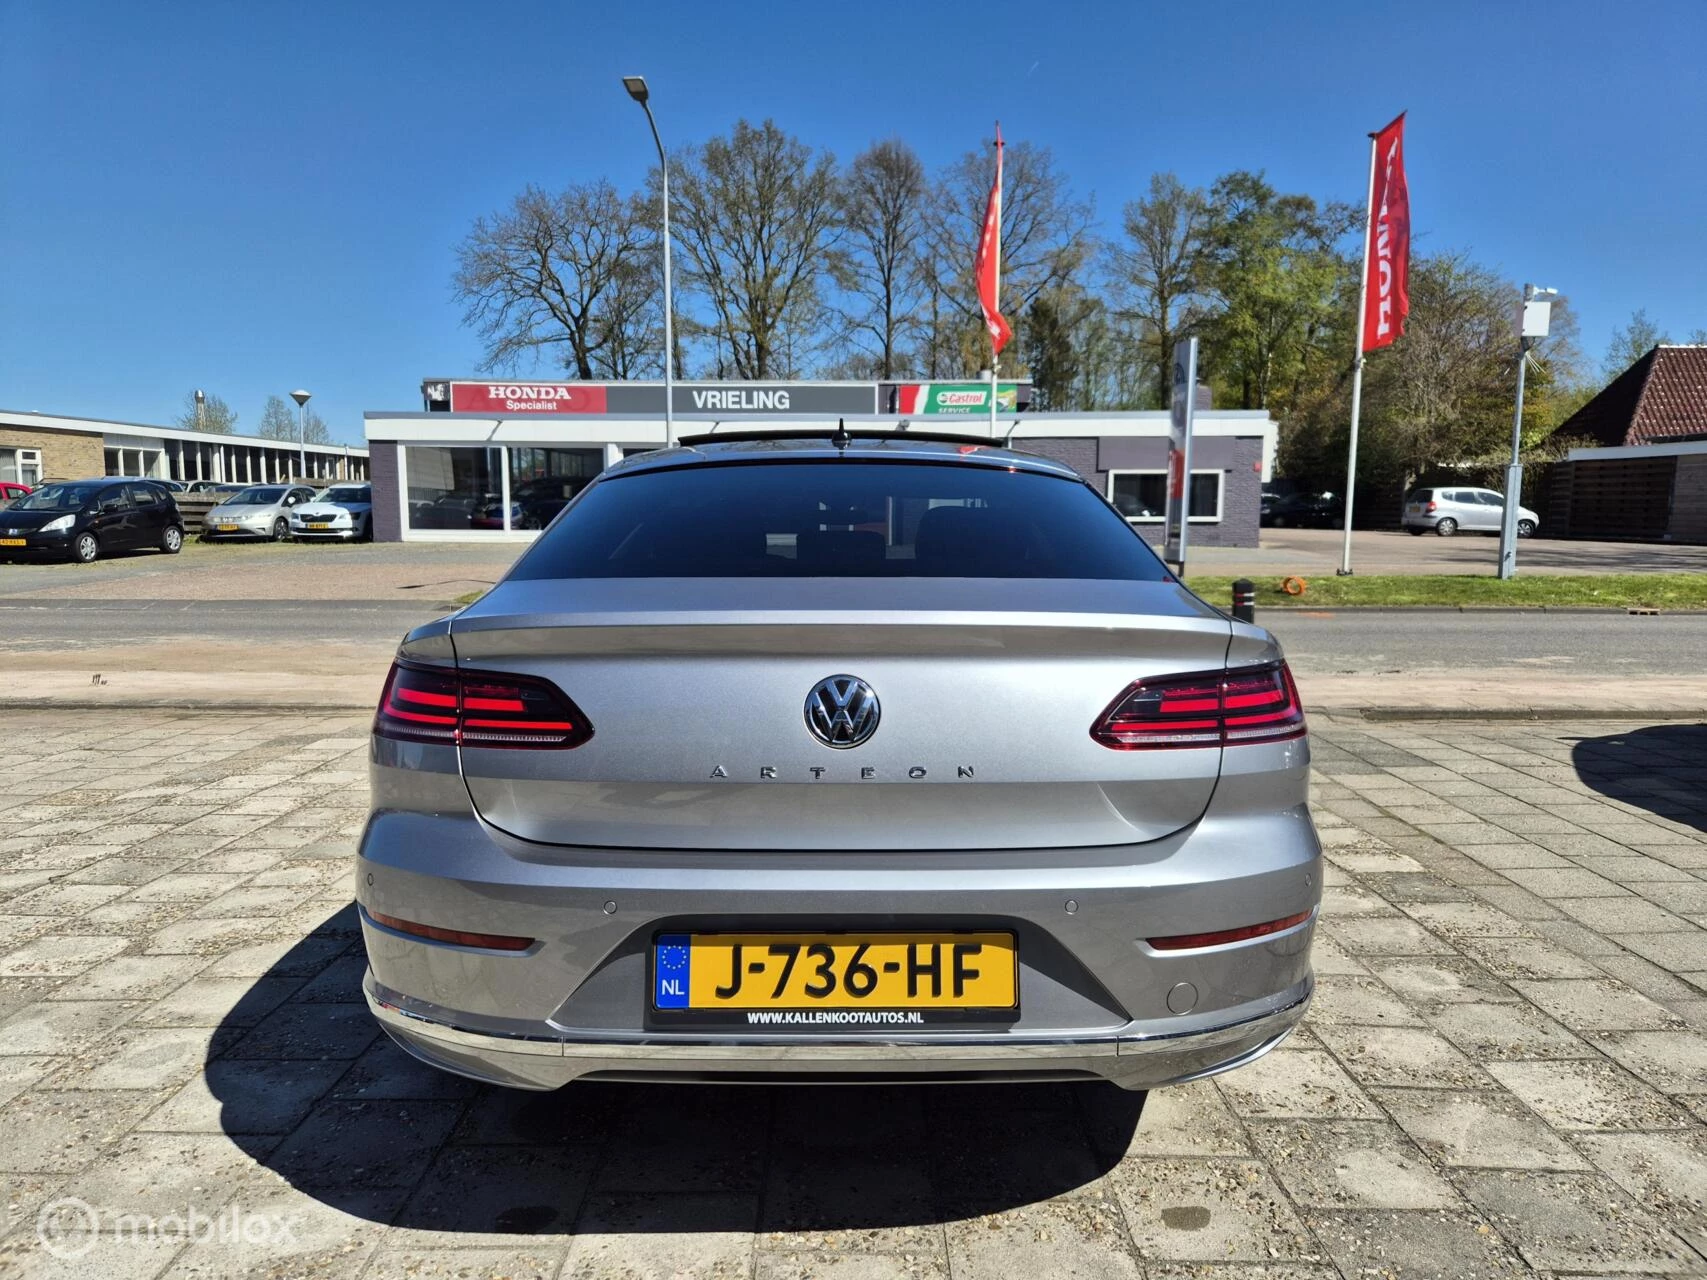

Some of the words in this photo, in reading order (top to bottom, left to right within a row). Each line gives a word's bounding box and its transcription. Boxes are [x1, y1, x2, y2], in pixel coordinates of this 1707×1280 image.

[488, 386, 572, 400] HONDA
[692, 390, 790, 409] VRIELING
[949, 393, 983, 404] Castrol
[506, 400, 557, 411] Specialist
[710, 765, 975, 780] ARTEON
[715, 943, 982, 999] J-736-HF
[661, 979, 685, 995] NL
[747, 1011, 924, 1024] WWW.KALLENKOOTAUTOS.NL
